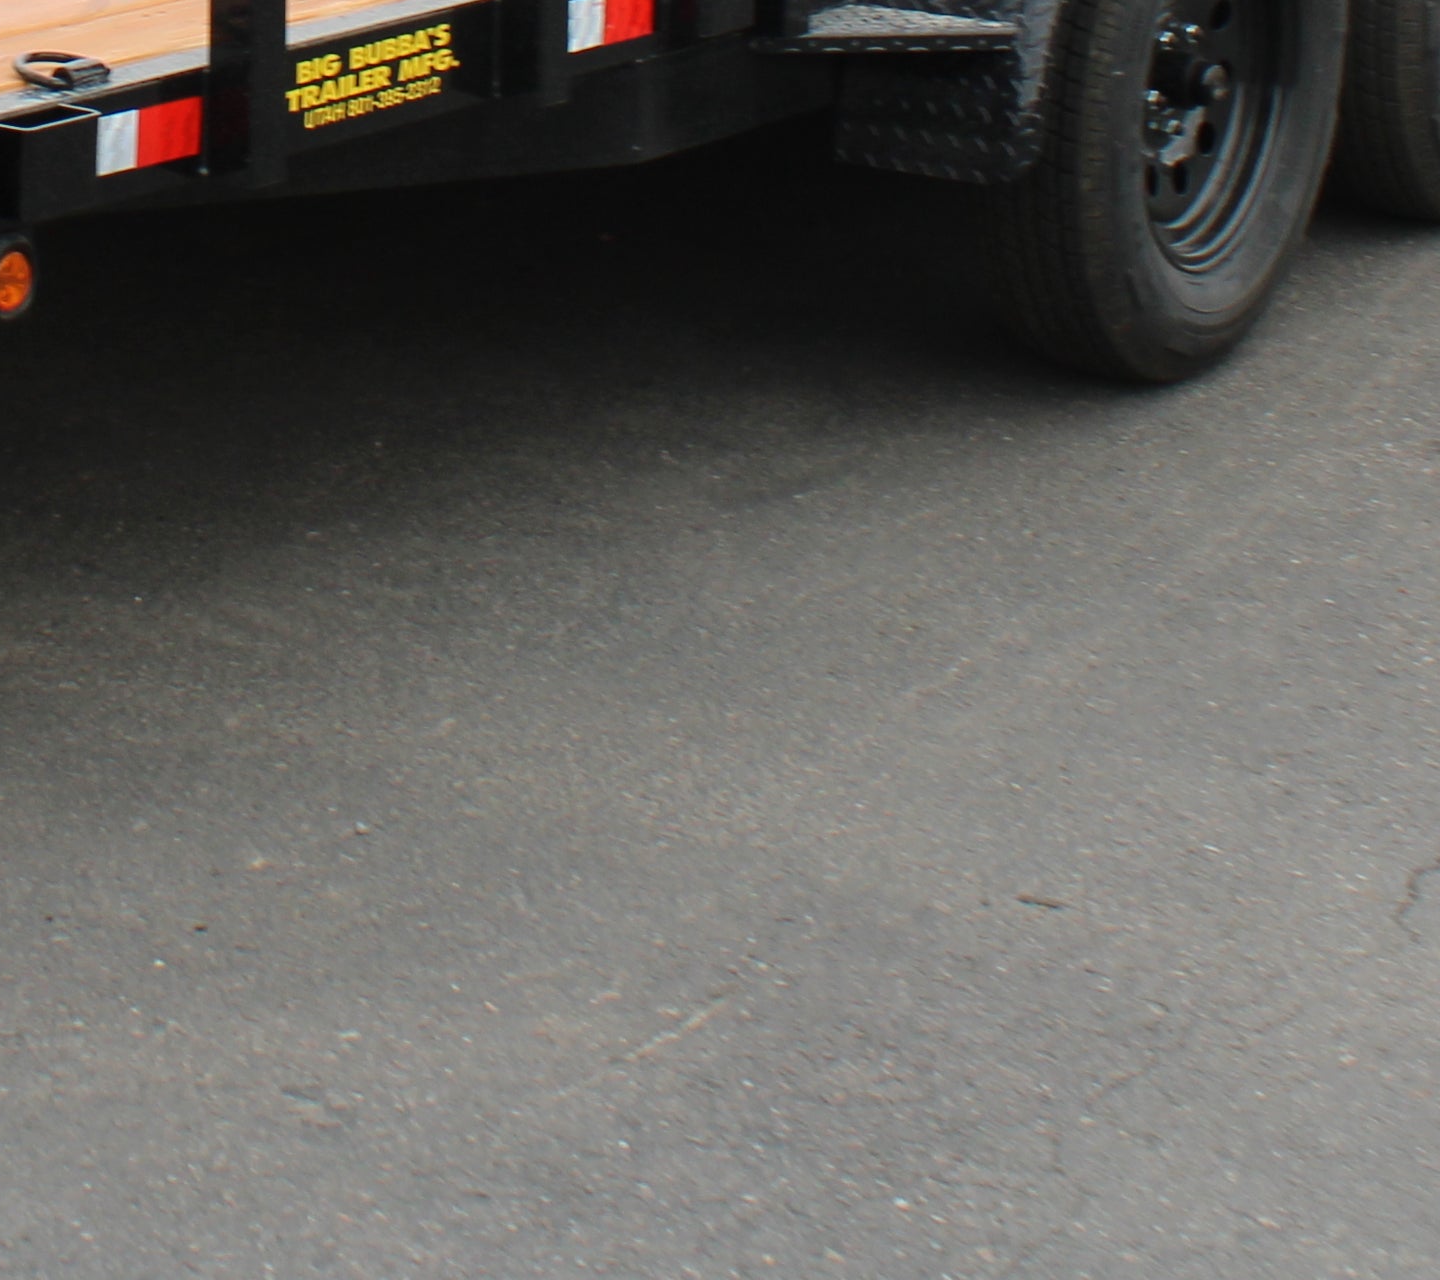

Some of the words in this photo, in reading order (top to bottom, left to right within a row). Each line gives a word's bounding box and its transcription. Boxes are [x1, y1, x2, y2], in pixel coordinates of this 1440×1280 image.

[285, 65, 392, 113] TRAILER
[397, 48, 461, 82] MFG.
[296, 53, 343, 85] BIG
[348, 23, 452, 71] BUBBA'S
[304, 100, 346, 129] UTAH
